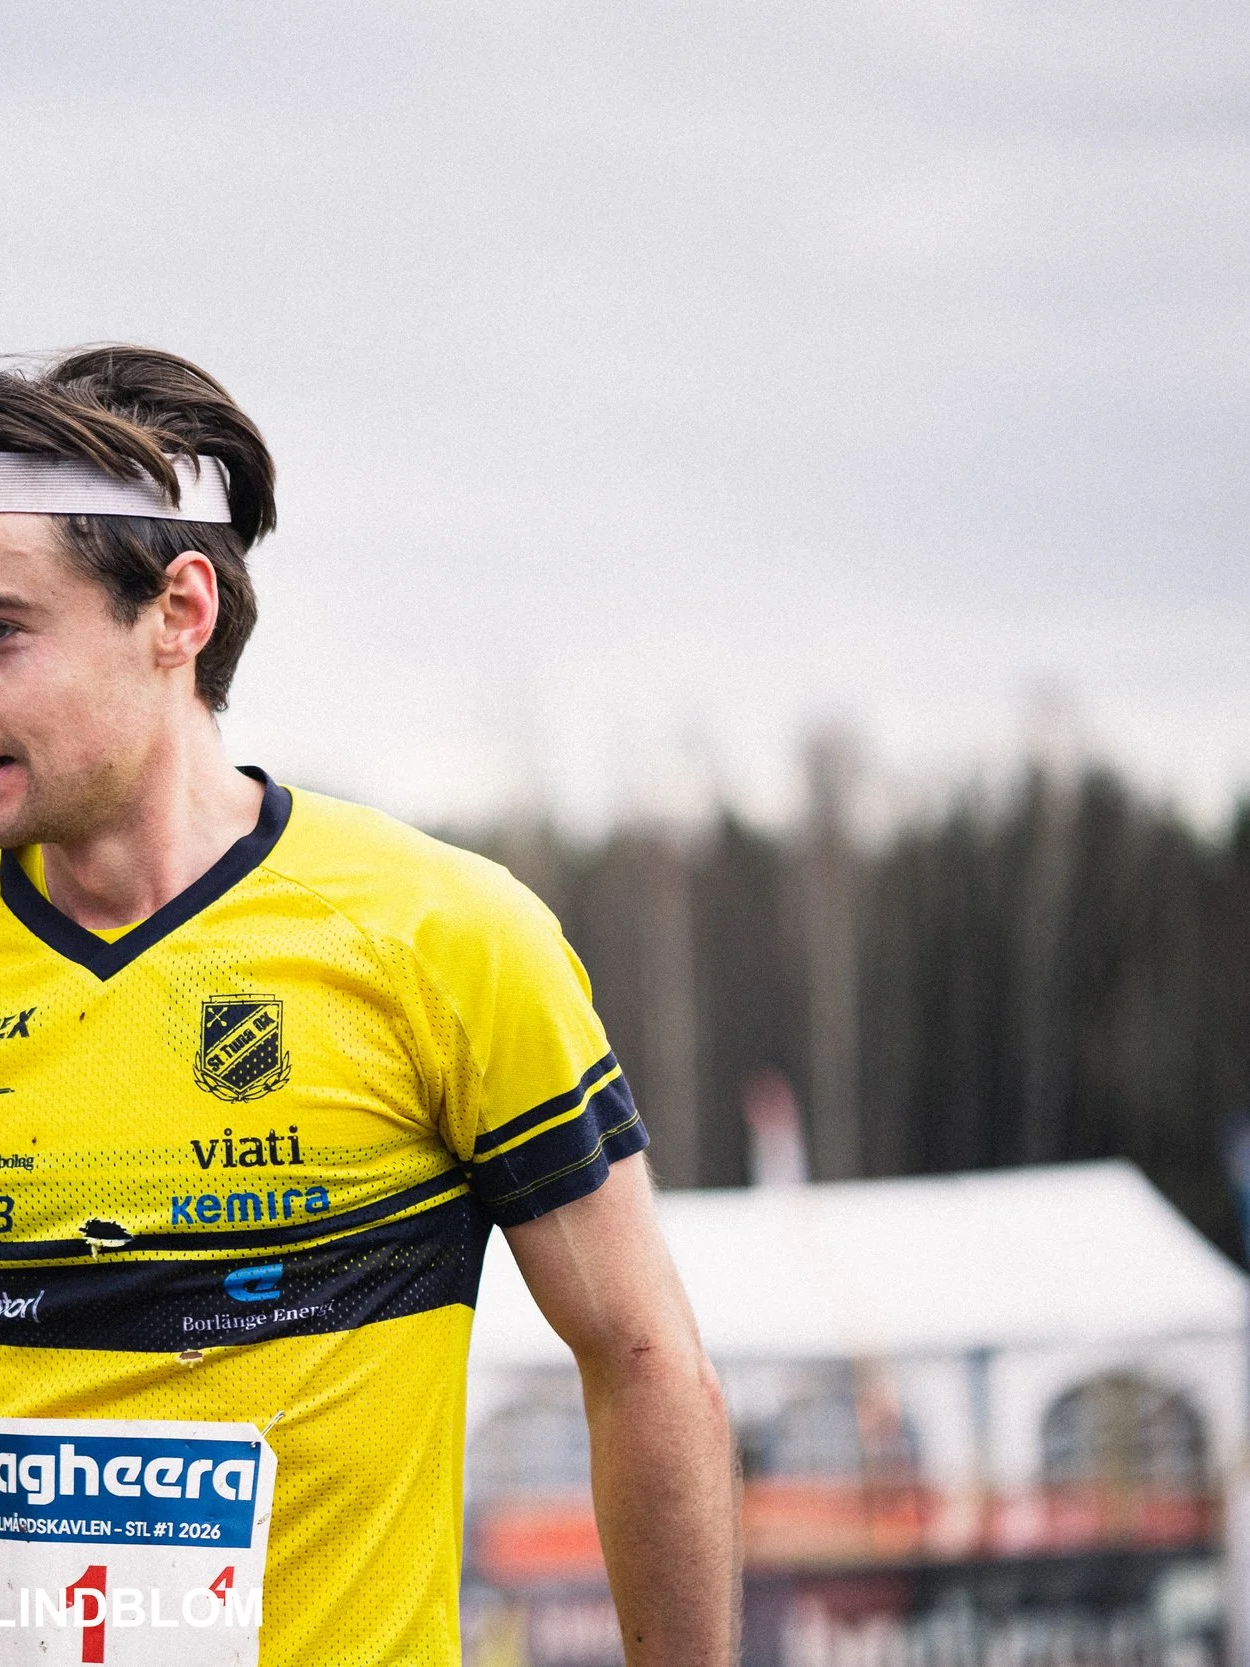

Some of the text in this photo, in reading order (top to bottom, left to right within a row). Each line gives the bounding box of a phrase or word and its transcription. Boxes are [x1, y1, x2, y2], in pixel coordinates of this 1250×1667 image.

[190, 1125, 304, 1169] viati
[183, 1313, 267, 1331] Borlänge
[125, 1521, 151, 1537] STL
[153, 1522, 174, 1537] #1
[179, 1523, 221, 1540] 2026
